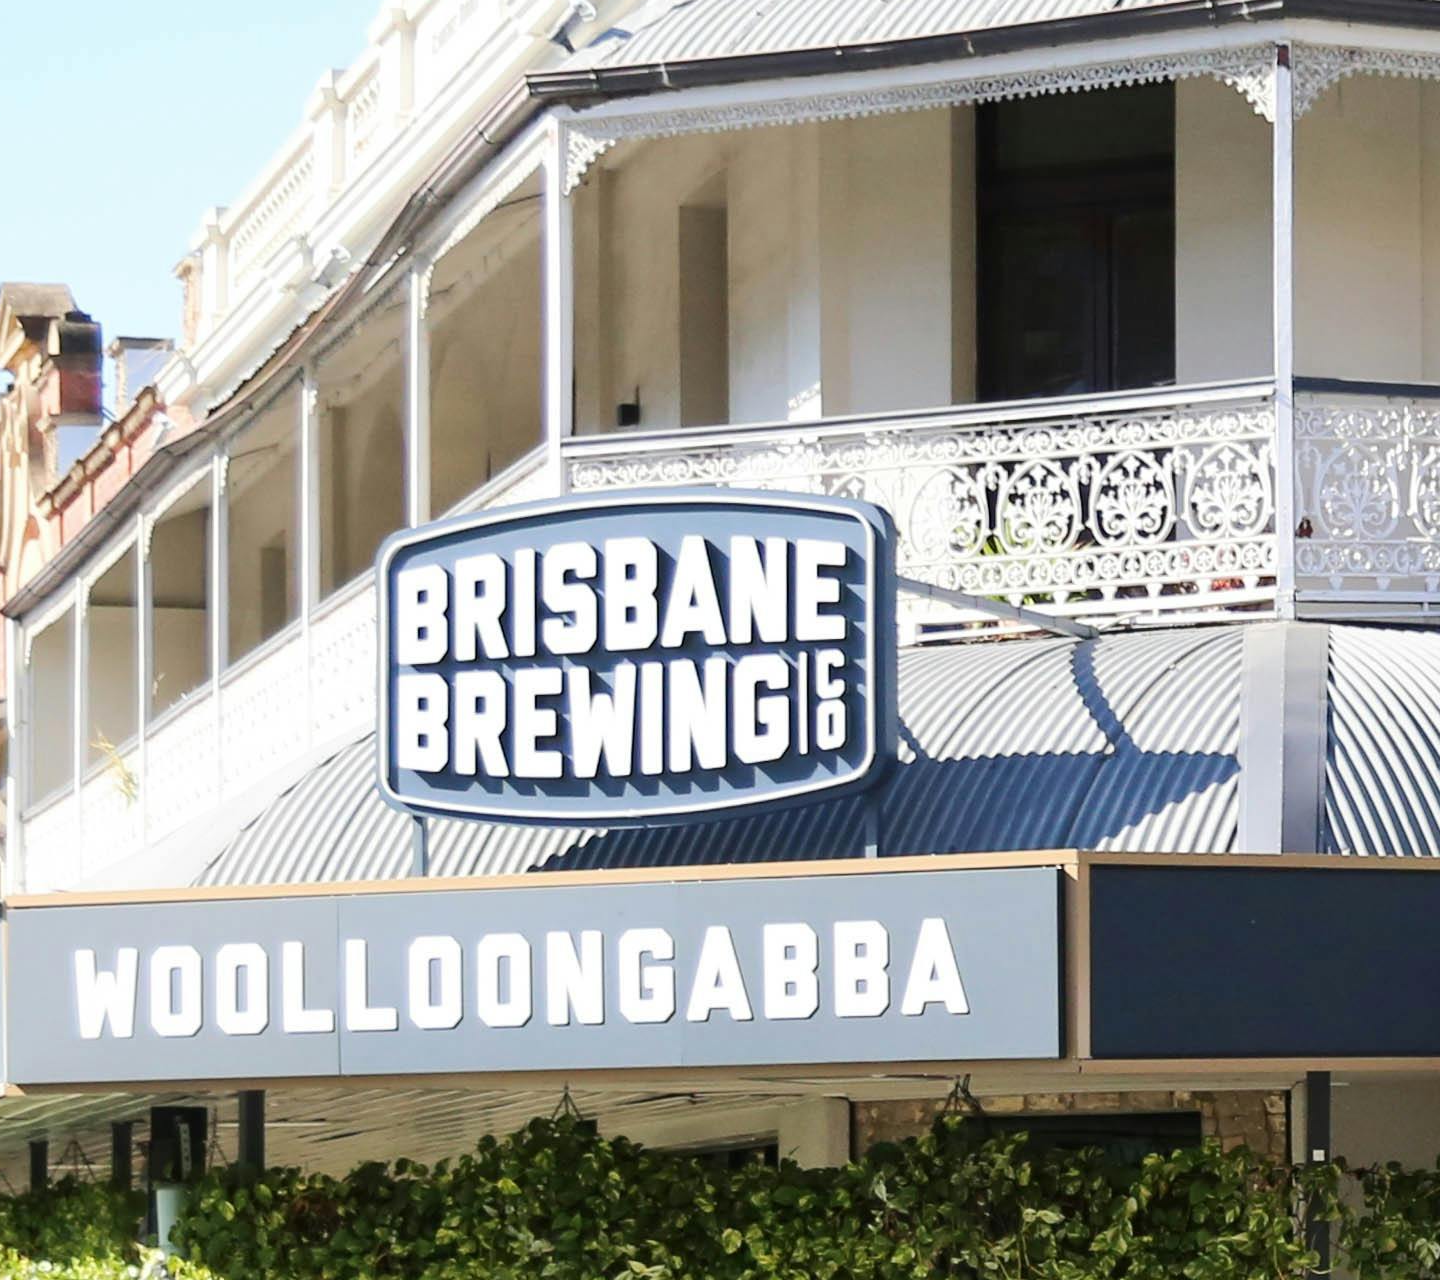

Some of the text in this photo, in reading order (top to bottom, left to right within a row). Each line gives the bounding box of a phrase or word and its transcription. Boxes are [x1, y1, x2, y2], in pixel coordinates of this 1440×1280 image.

[397, 535, 847, 665] BRISBANE
[397, 653, 790, 779] BREWING
[74, 916, 970, 1039] WOOLLOONGABBA
